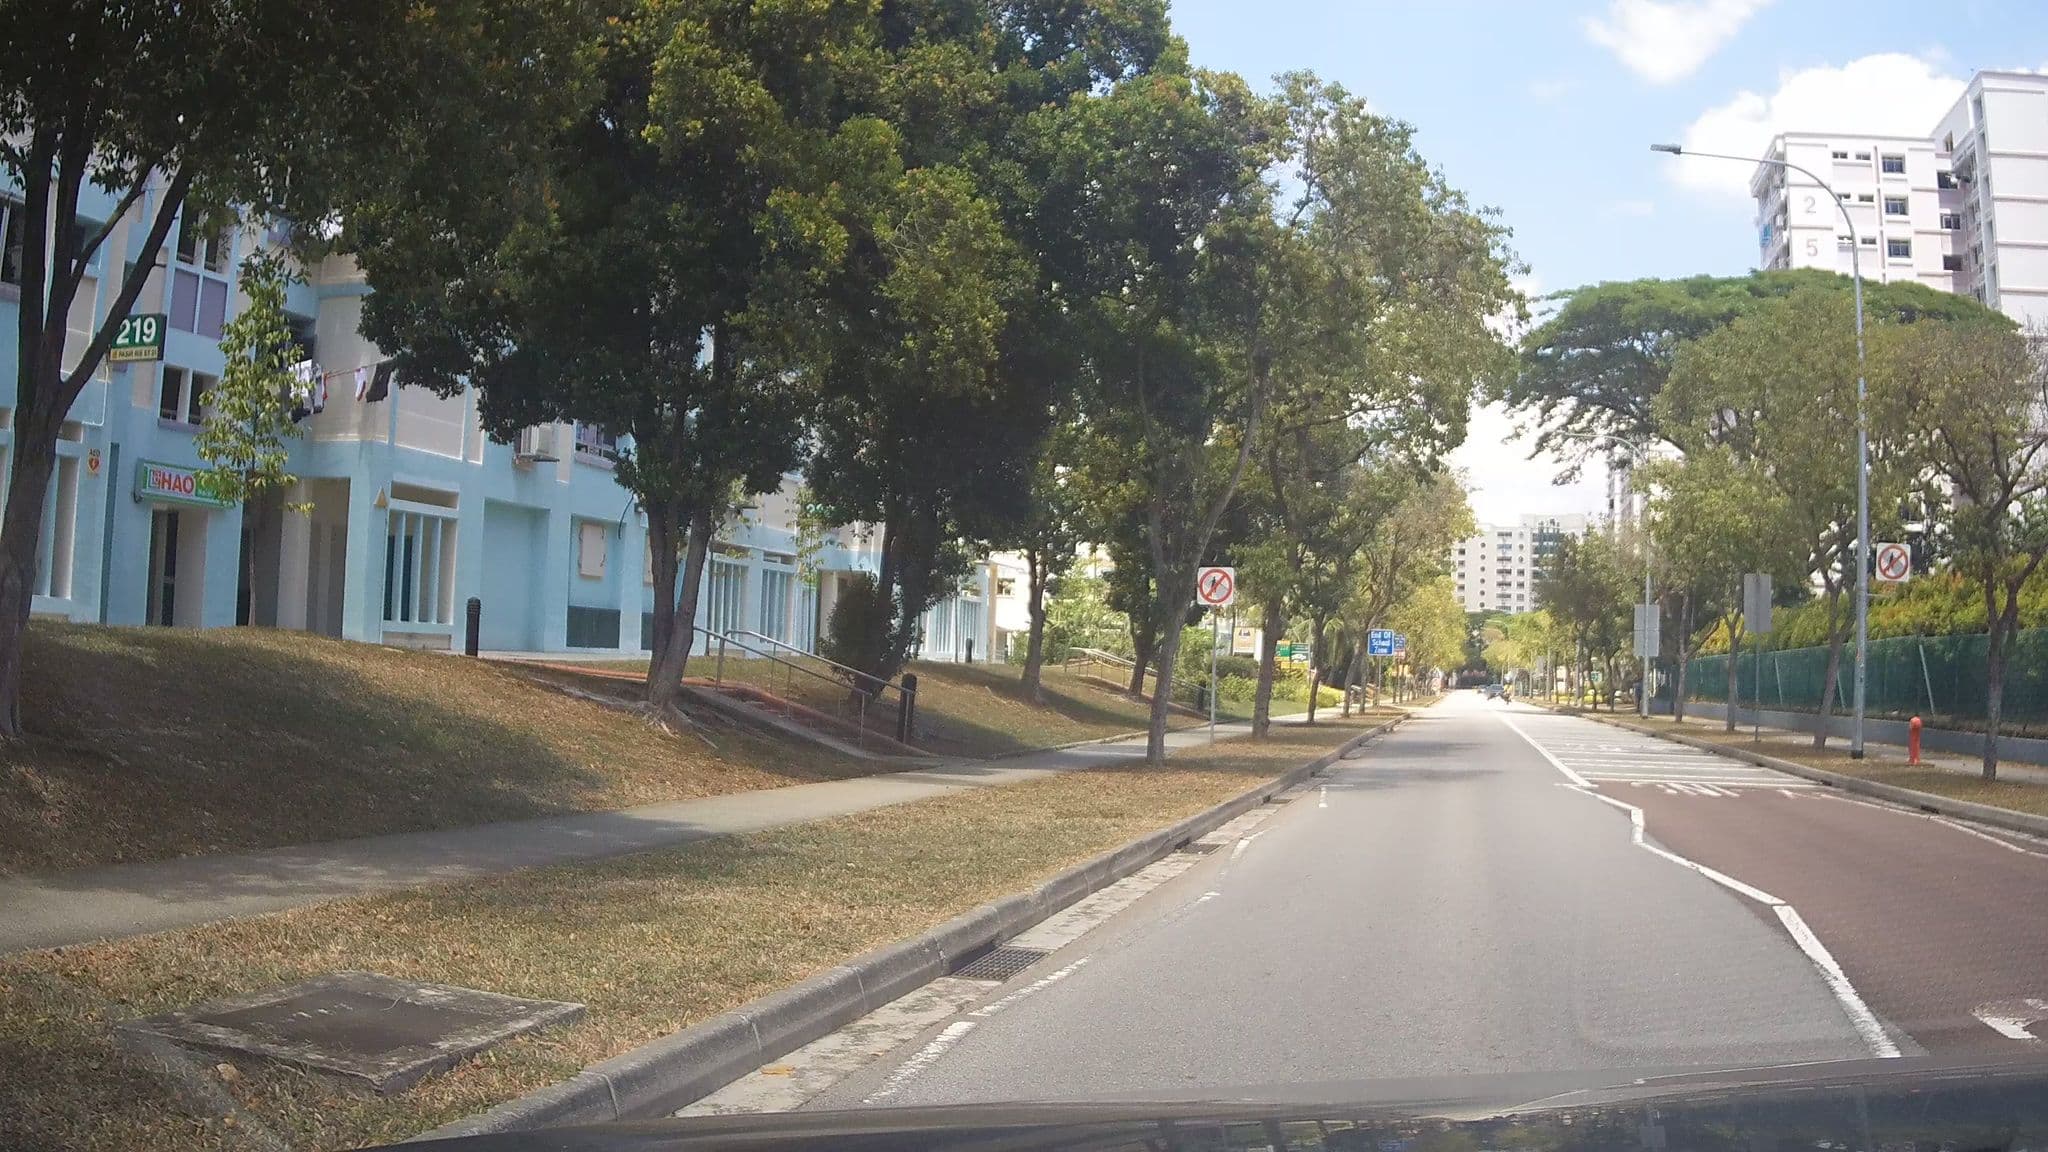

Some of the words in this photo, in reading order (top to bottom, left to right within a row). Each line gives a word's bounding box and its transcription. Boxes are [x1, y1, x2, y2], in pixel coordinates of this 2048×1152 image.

[116, 317, 156, 346] 219
[1383, 631, 1391, 639] Of
[1372, 638, 1391, 646] School
[1374, 646, 1388, 654] Zone
